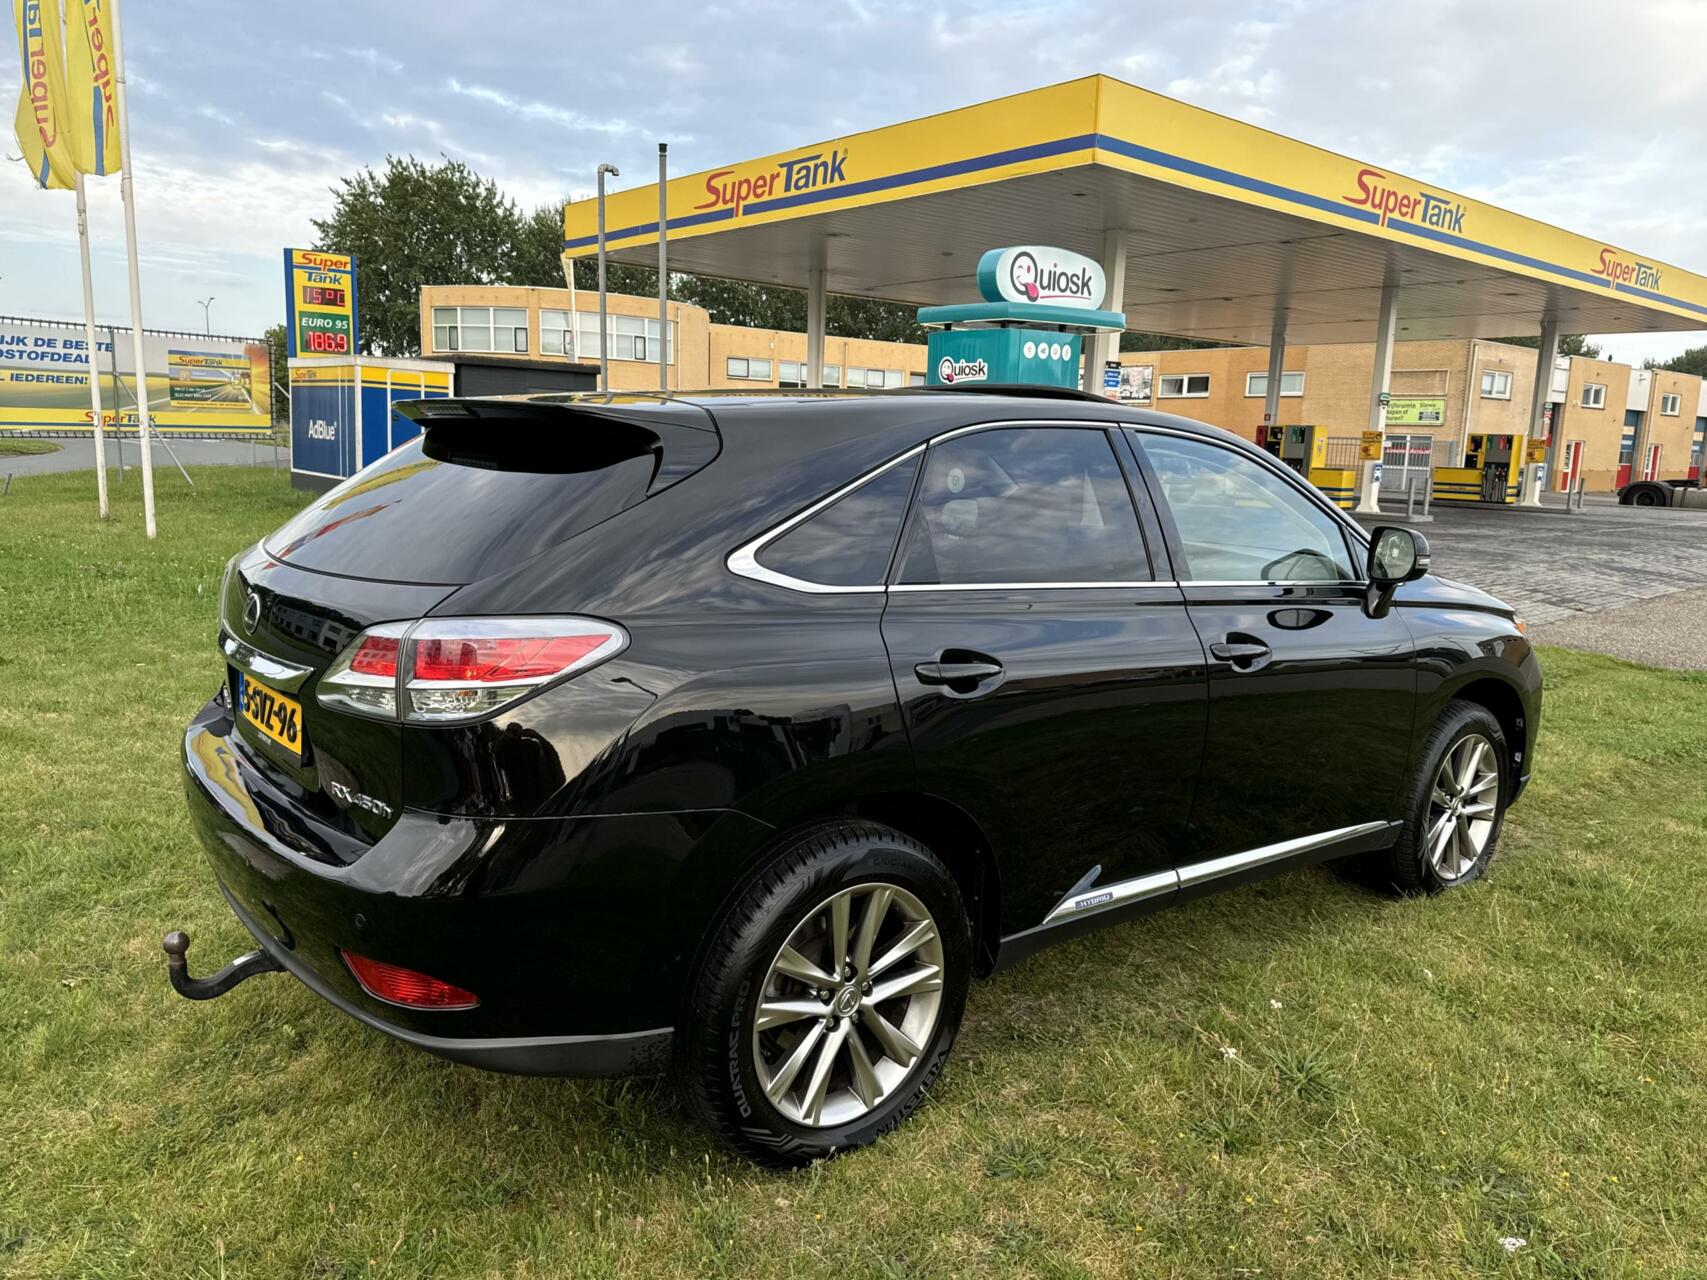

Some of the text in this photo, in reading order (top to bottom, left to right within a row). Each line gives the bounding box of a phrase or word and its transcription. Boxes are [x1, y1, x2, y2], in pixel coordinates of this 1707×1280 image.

[693, 150, 848, 217] SuperTank
[1342, 169, 1466, 233] SuperTank
[293, 252, 350, 272] Super
[1590, 248, 1662, 291] SuperTank
[303, 270, 343, 285] Tank
[1010, 251, 1092, 302] Quiosk
[301, 317, 348, 329] EURO 95
[34, 337, 57, 348] DE
[10, 373, 88, 385] IEDEREEN!
[940, 358, 986, 383] Quiosk
[79, 411, 156, 427] SperTak
[308, 419, 336, 440] AdBlue
